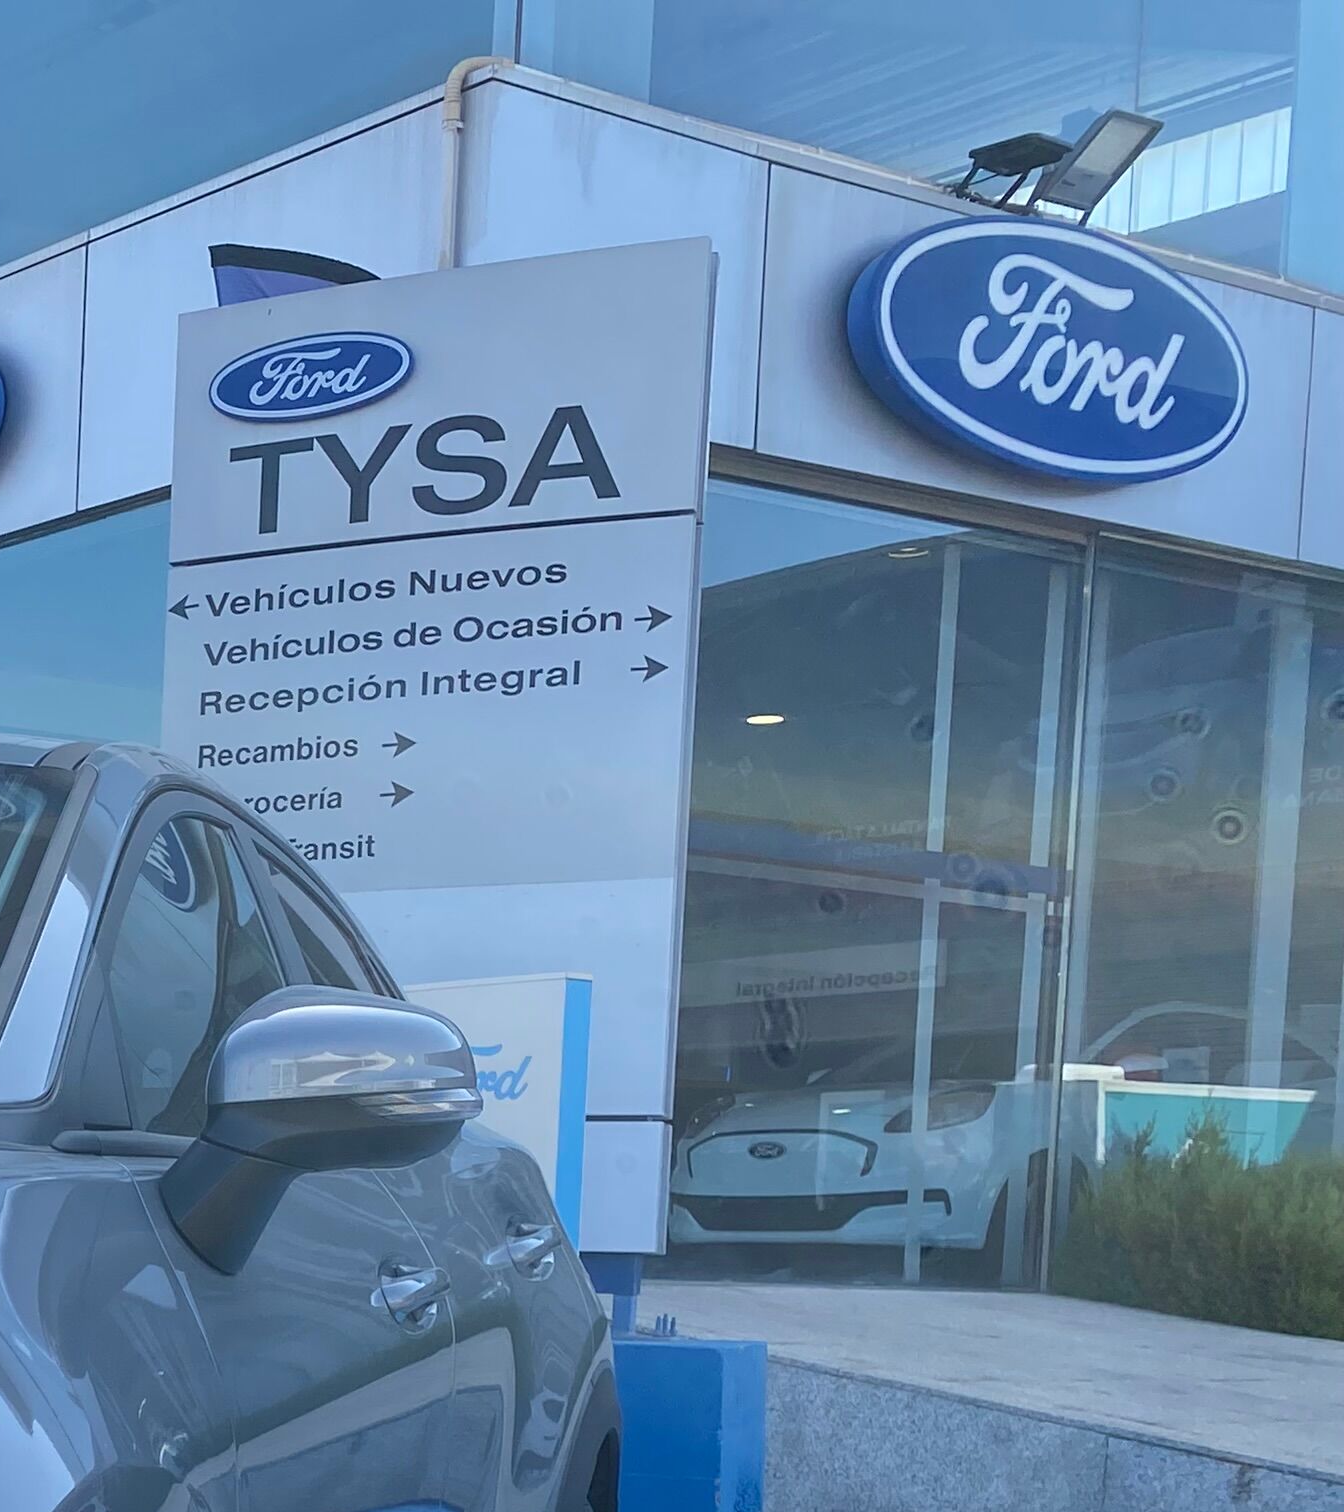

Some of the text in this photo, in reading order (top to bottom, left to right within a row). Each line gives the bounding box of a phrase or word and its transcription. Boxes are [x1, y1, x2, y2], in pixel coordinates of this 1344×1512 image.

[958, 253, 1185, 430] Ford
[249, 347, 371, 407] Ford
[229, 405, 621, 534] TYSA
[204, 560, 568, 618] Vehículos Nuevos
[203, 605, 623, 666] Vehículos de Ocasión
[199, 660, 582, 717] Recepción Integral
[198, 734, 360, 769] Recambios
[244, 786, 342, 814] ocería
[289, 834, 375, 860] ansit
